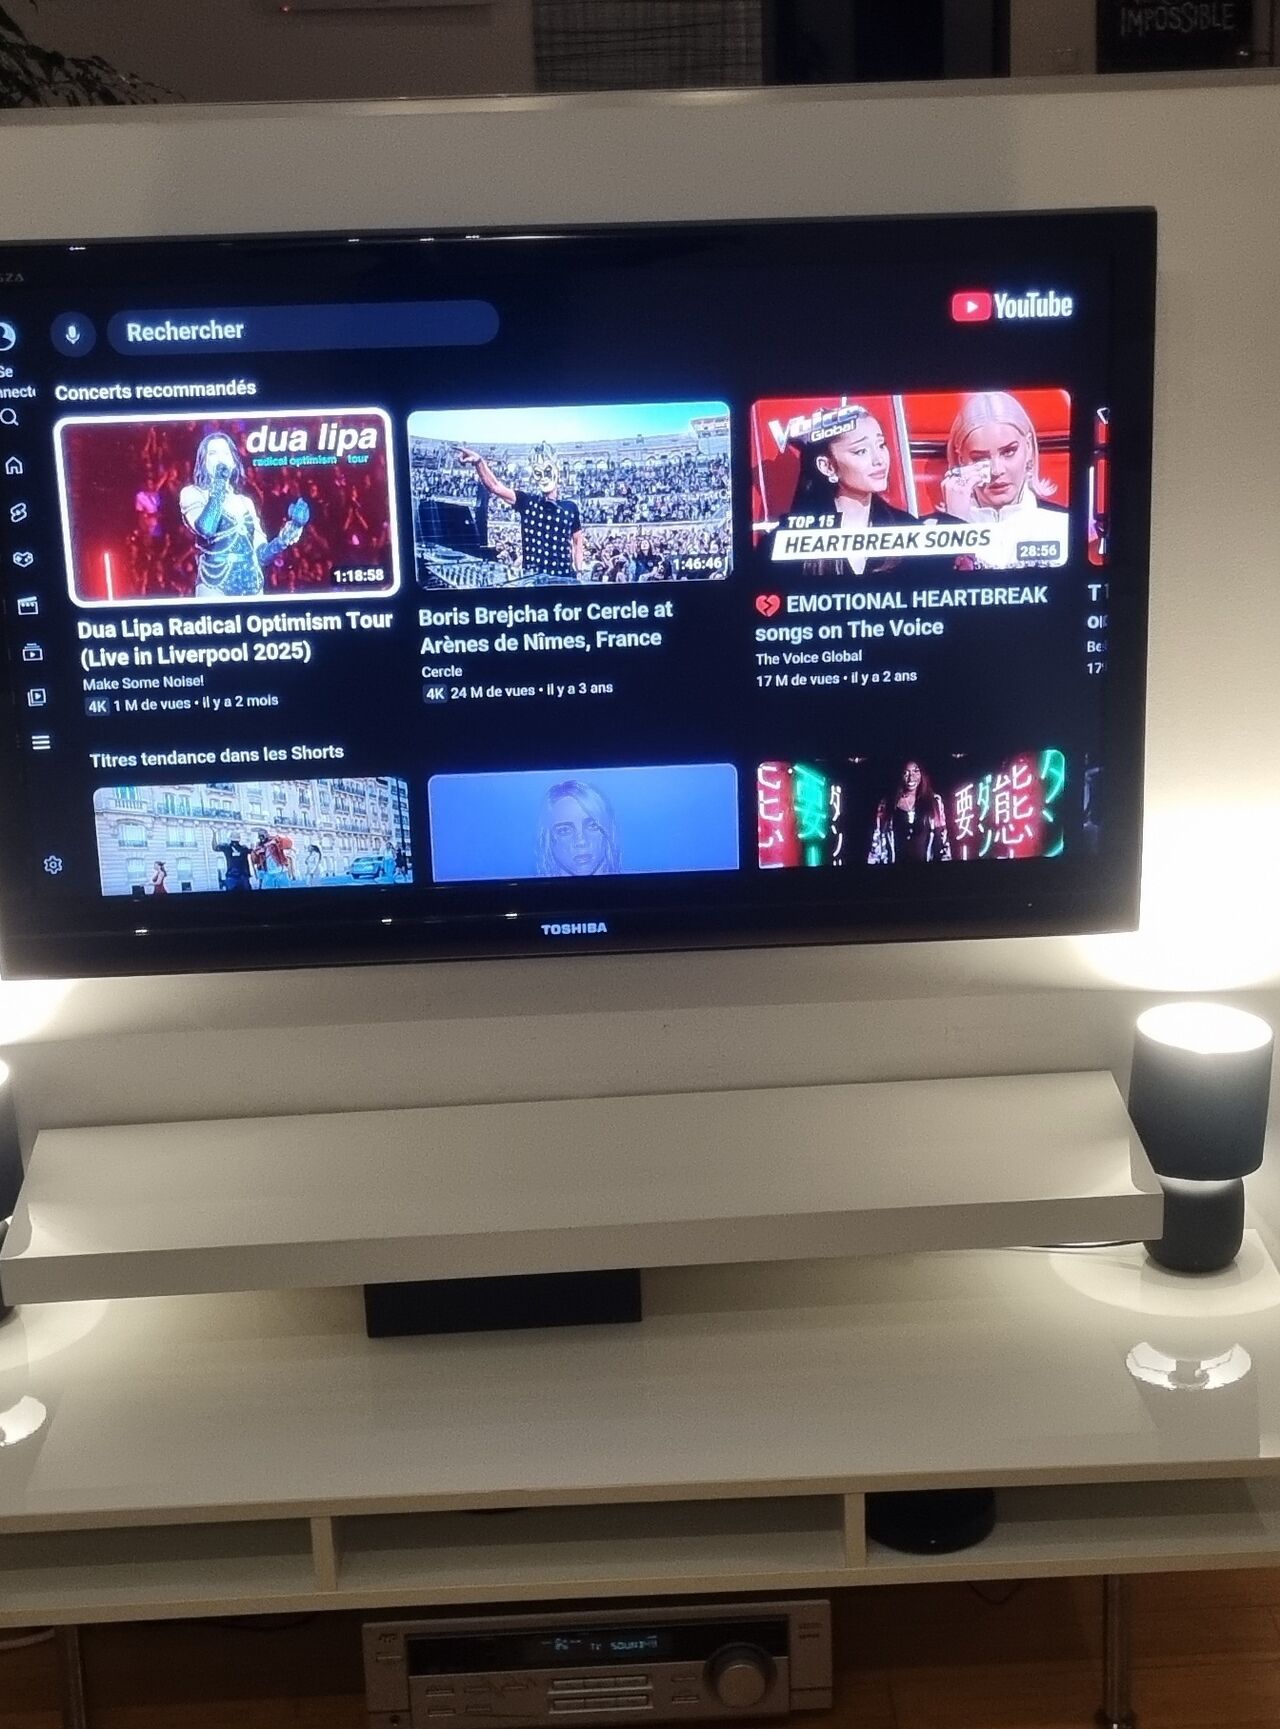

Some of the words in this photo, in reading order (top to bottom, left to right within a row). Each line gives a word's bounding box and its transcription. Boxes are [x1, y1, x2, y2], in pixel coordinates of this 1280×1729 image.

[1121, 2, 1237, 36] IMPOSSIBLE
[993, 291, 1073, 319] YouTube
[126, 320, 245, 343] Rechercher
[55, 381, 132, 402] Concerts
[136, 379, 257, 399] recommandés
[246, 425, 308, 454] dua
[317, 422, 378, 457] lipa
[810, 419, 855, 442] Global
[252, 454, 288, 467] radical
[289, 453, 337, 468] optimism
[347, 453, 370, 464] tour
[787, 515, 816, 529] TOP
[819, 514, 835, 528] 15
[784, 531, 921, 554] HEARTBREAK
[924, 528, 992, 549] SONGS
[1019, 544, 1058, 559] 28:56
[672, 556, 723, 571] 1:46:46
[333, 567, 385, 584] 1:18:58
[786, 591, 908, 613] EMOTIONAL
[912, 586, 1049, 609] HEARTBREAK
[418, 607, 470, 627] Boris
[474, 603, 549, 629] Brejcha
[553, 603, 582, 621] for
[586, 600, 650, 621] Cercle
[653, 600, 674, 618] at
[77, 621, 117, 640] Dua
[121, 619, 164, 642] Lipa
[169, 615, 242, 637] Radical
[246, 612, 342, 637] Optimism
[345, 611, 394, 630] Tour
[755, 625, 814, 645] songs
[818, 623, 843, 640] on
[847, 619, 885, 639] The
[889, 618, 945, 638] Voice
[420, 633, 490, 655] Arènes
[494, 633, 519, 652] de
[523, 632, 592, 654] Nîmes,
[595, 630, 663, 649] France
[80, 648, 130, 672] (Live
[133, 647, 153, 666] in
[157, 642, 249, 668] Liverpool
[253, 640, 312, 664] 2025)
[756, 652, 781, 667] The
[782, 651, 819, 665] Voice
[821, 649, 863, 664] Global
[83, 678, 120, 692] Make
[121, 676, 161, 690] Some
[163, 675, 205, 688] Noise!
[421, 665, 463, 679] Cercle
[757, 674, 773, 688] 17
[775, 673, 789, 687] M
[791, 672, 808, 687] de
[810, 673, 840, 686] vues
[851, 670, 859, 685] il
[861, 673, 869, 687] y
[871, 672, 880, 684] a
[882, 670, 892, 683] 2
[894, 670, 918, 683] ans
[426, 687, 445, 701] 4K
[451, 687, 468, 700] 24
[470, 685, 484, 699] M
[486, 685, 503, 698] de
[505, 686, 536, 698] vues
[547, 683, 555, 696] il
[556, 686, 566, 699] y
[567, 685, 577, 696] a
[578, 682, 588, 695] 3
[590, 682, 614, 694] ans
[88, 700, 107, 714] 4K
[113, 700, 121, 712] 1
[124, 699, 139, 712] M
[140, 698, 159, 712] de
[160, 699, 192, 711] vues
[202, 696, 211, 709] il
[212, 698, 221, 712] y
[223, 698, 233, 709] a
[234, 695, 245, 708] 2
[246, 694, 279, 708] mois
[89, 752, 138, 769] Titres
[140, 748, 216, 766] tendance
[219, 747, 260, 764] dans
[263, 746, 288, 762] les
[291, 743, 345, 761] Shorts
[540, 921, 608, 936] TOSHIBA
